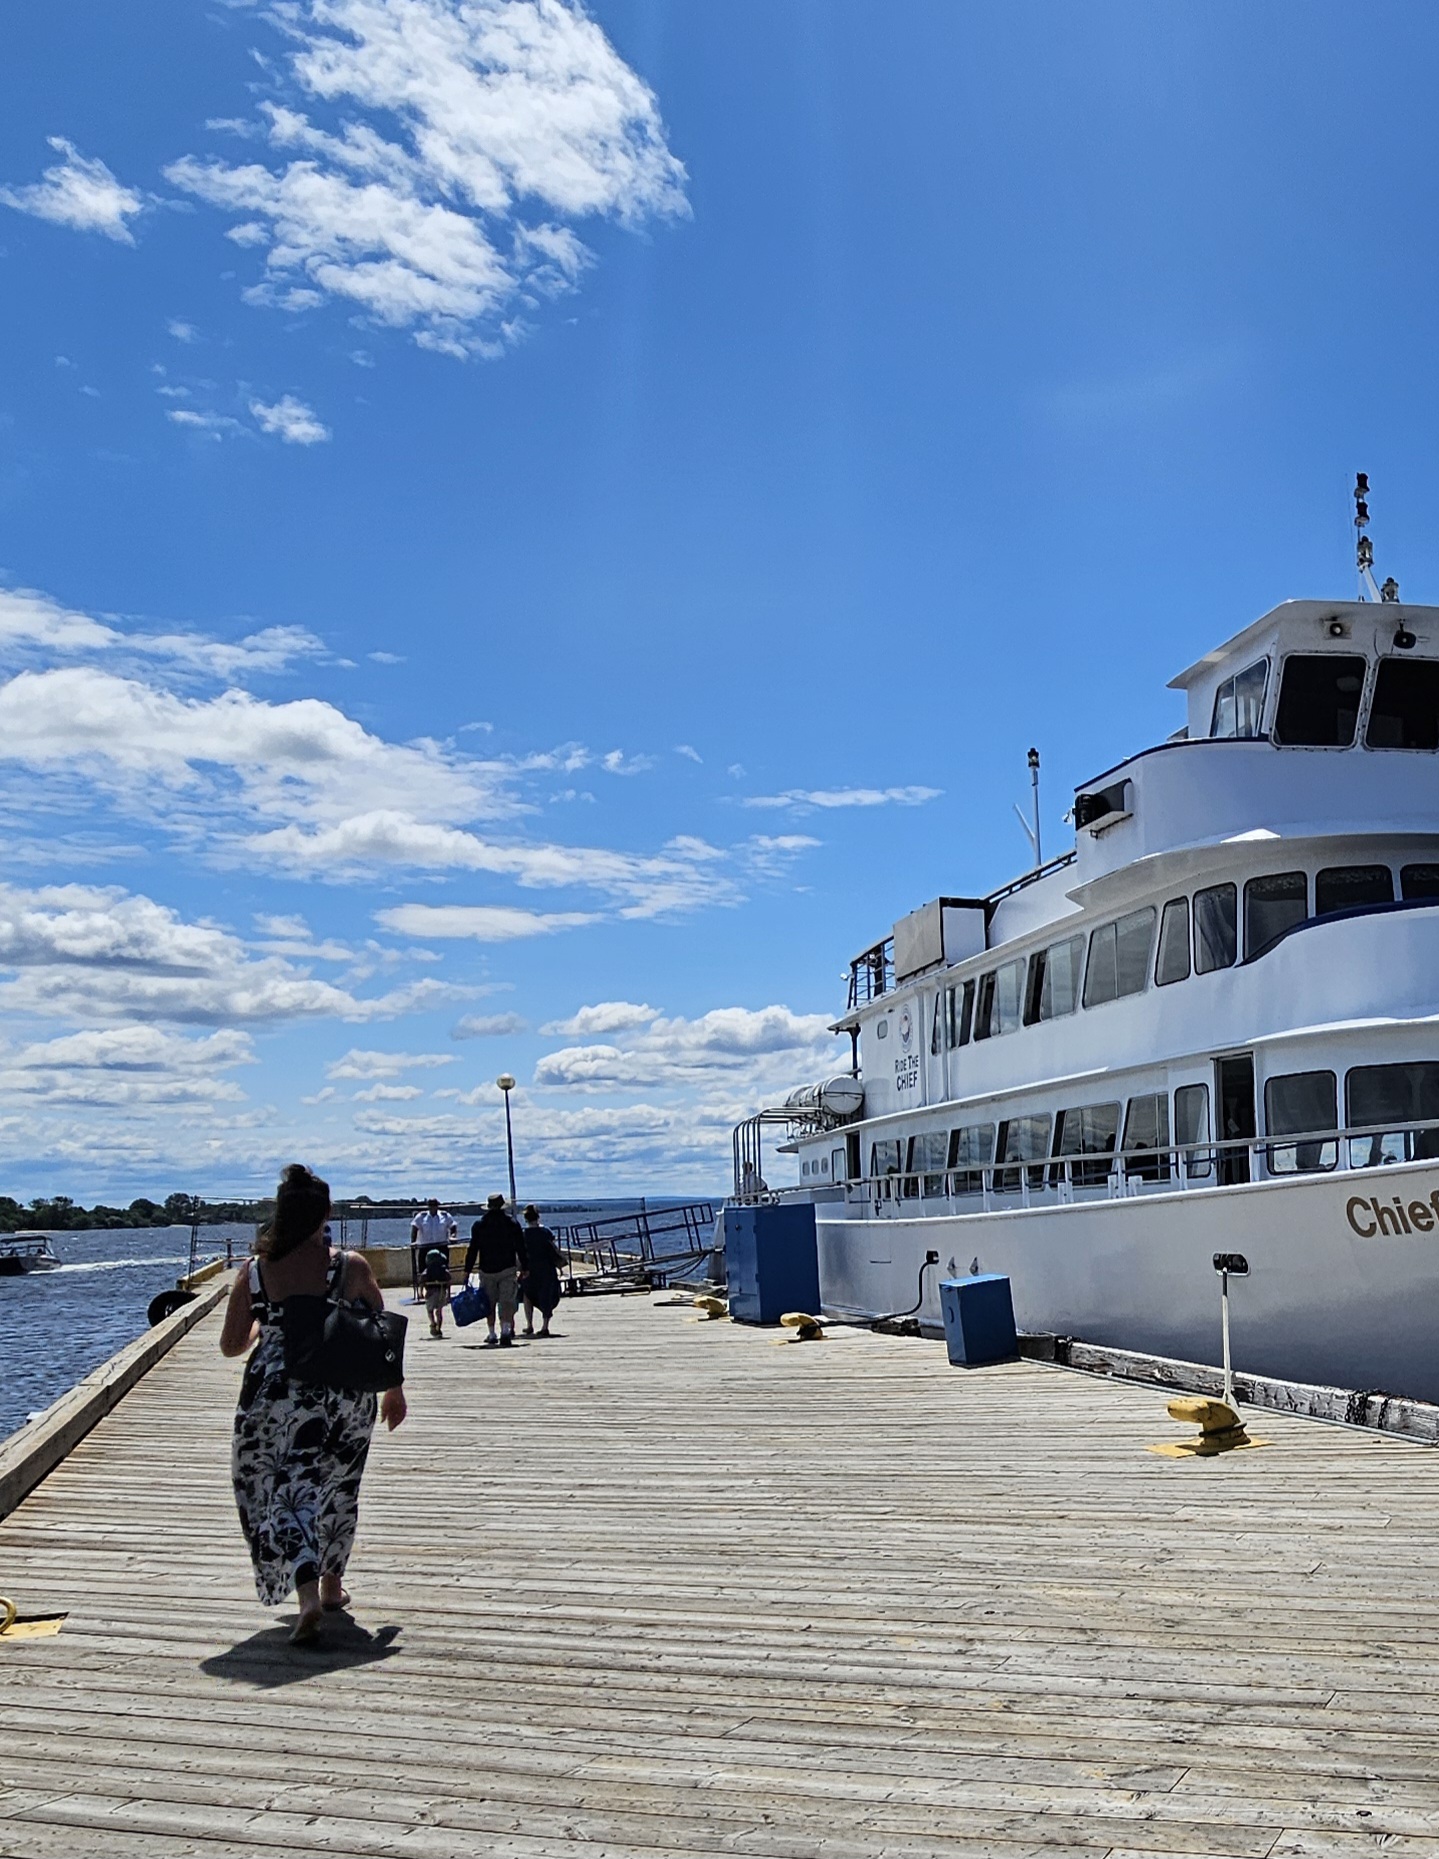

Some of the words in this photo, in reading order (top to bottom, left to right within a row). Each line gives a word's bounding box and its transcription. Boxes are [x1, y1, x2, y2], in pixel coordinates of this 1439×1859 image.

[895, 1059, 907, 1073] RIDE
[908, 1055, 919, 1069] THE
[897, 1071, 918, 1091] CHIEF
